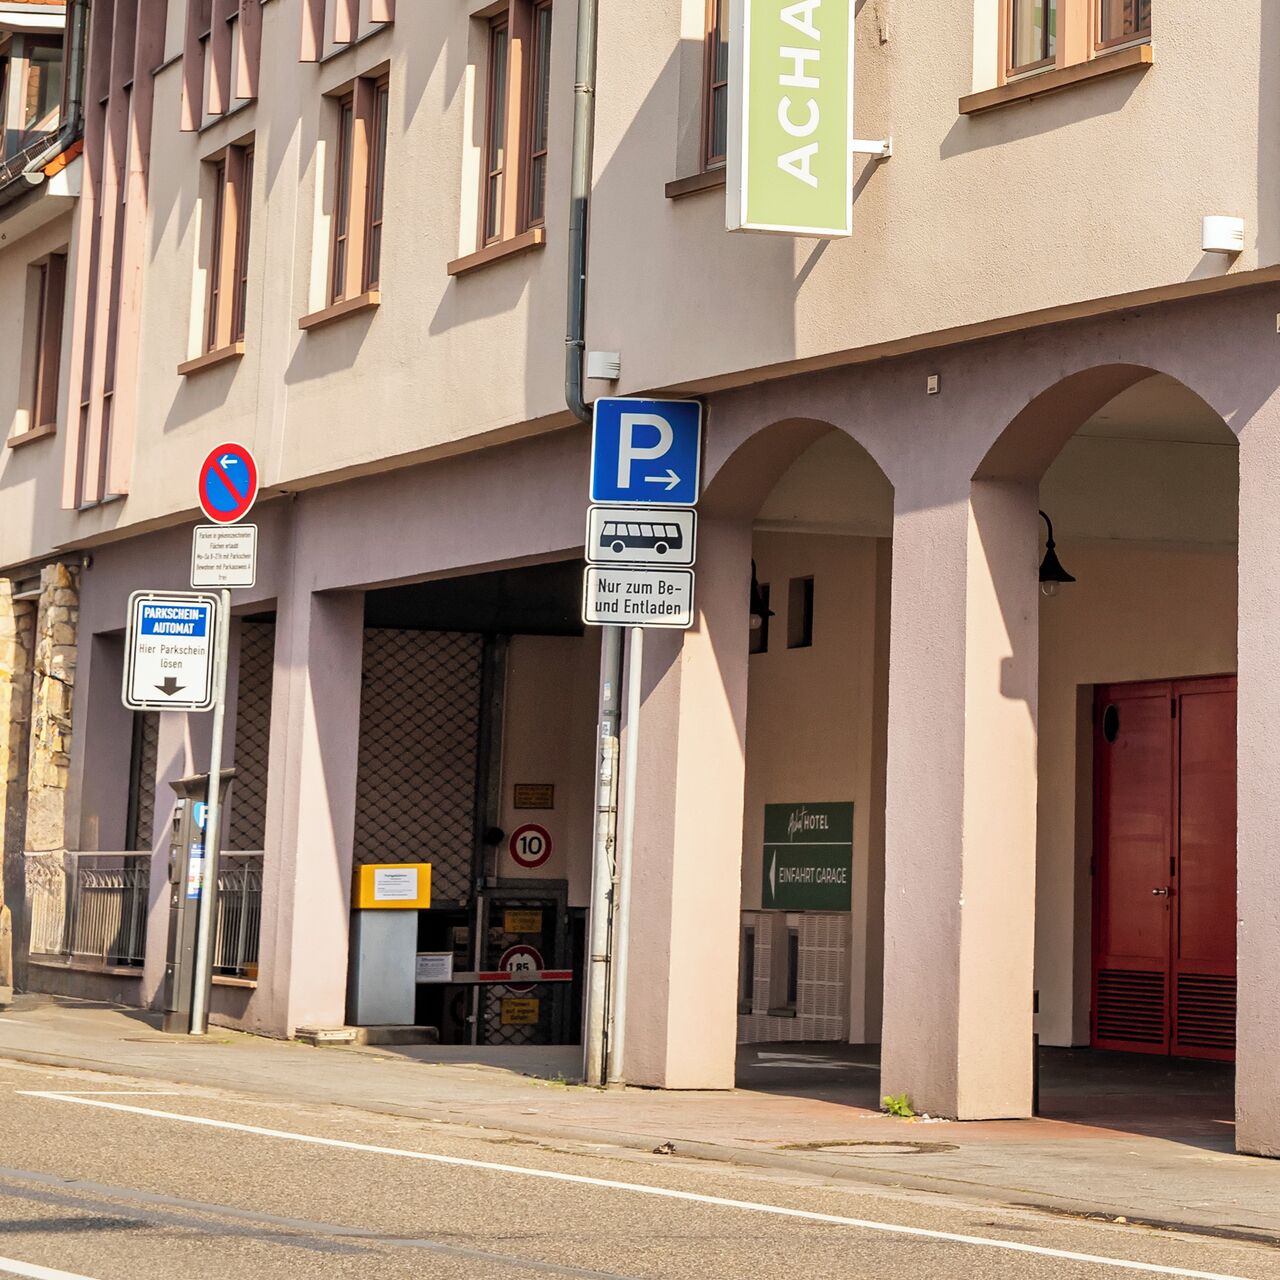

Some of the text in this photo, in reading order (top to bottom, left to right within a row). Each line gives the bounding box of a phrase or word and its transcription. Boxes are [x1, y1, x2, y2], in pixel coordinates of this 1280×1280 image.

[616, 412, 674, 489] P
[597, 578, 682, 595] Nur zum Be-
[144, 607, 205, 620] PARKSCHEIN-
[595, 598, 681, 615] und Entladen
[153, 621, 195, 634] AUTOMAT
[139, 643, 206, 655] Hier Parkschein
[160, 658, 183, 669] lösen
[803, 814, 829, 830] HOTEL
[520, 836, 543, 855] 10
[779, 867, 847, 884] EINFAHRT GARAGE
